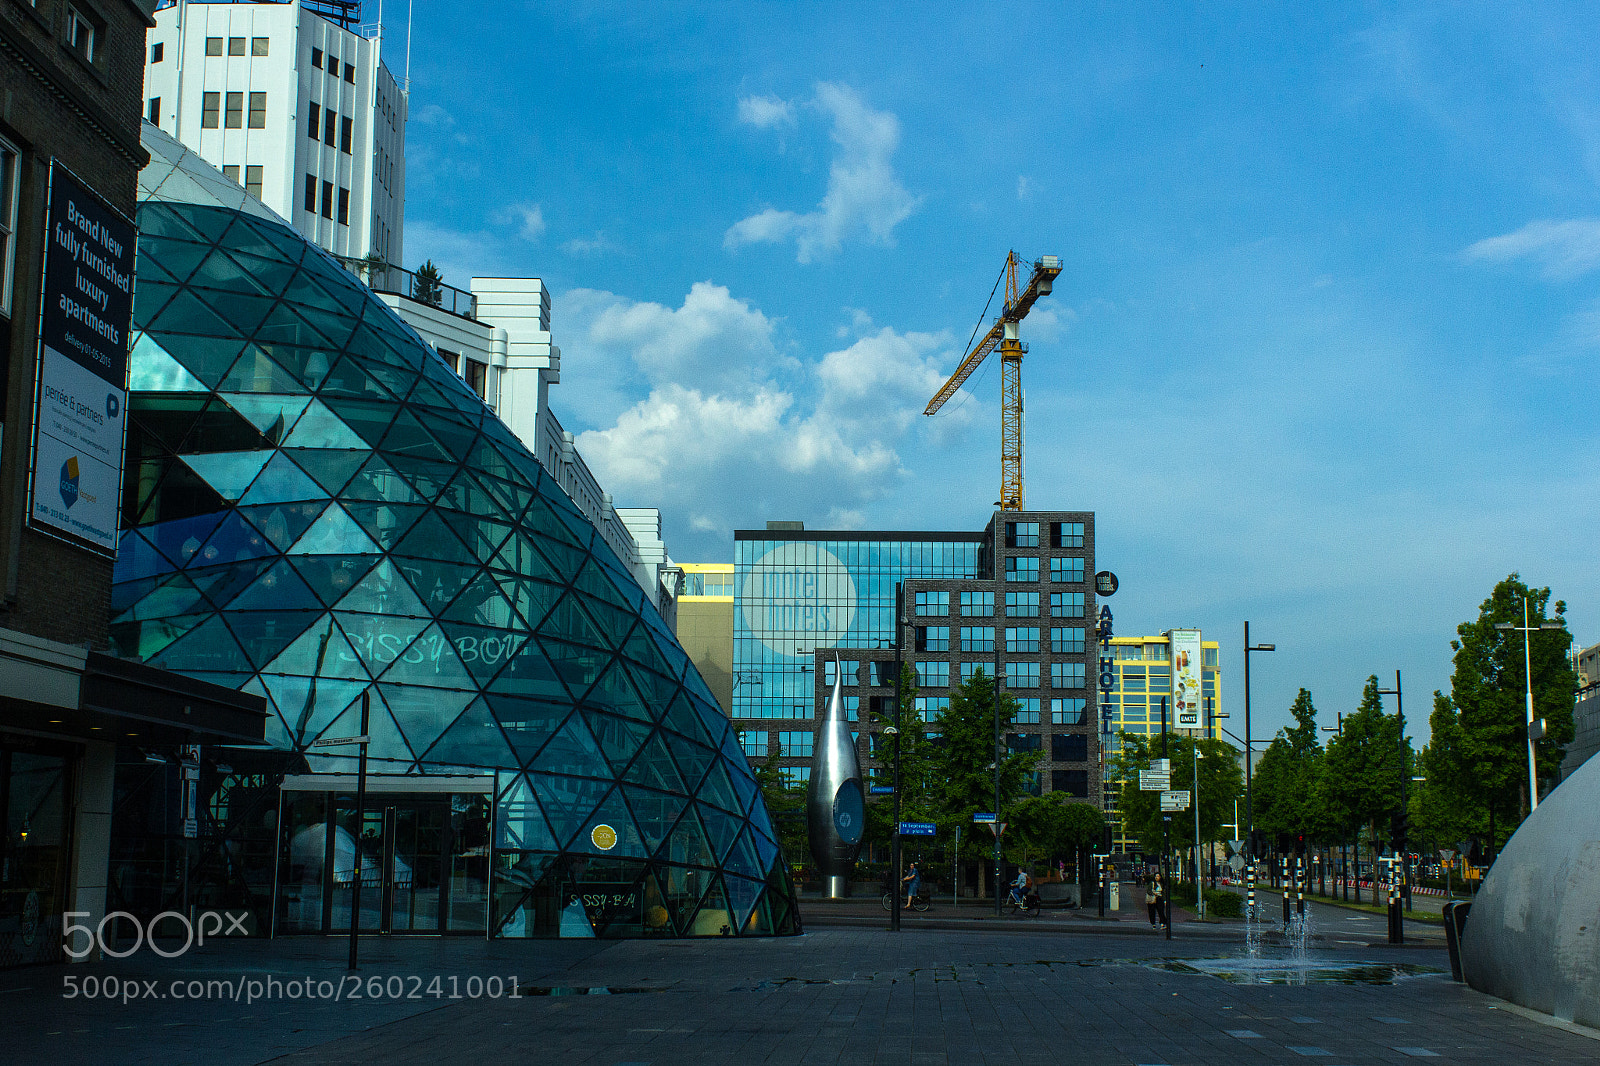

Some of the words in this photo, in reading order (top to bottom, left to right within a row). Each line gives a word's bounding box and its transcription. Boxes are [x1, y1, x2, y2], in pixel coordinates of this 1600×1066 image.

[67, 200, 99, 242] Brand
[101, 225, 123, 260] New
[55, 222, 80, 260] fully
[81, 241, 130, 294] furnished
[74, 266, 109, 312] luxury
[60, 293, 119, 346] apartments
[69, 395, 76, 410] &
[76, 401, 103, 426] partners
[339, 631, 528, 673] SISSY-BOY
